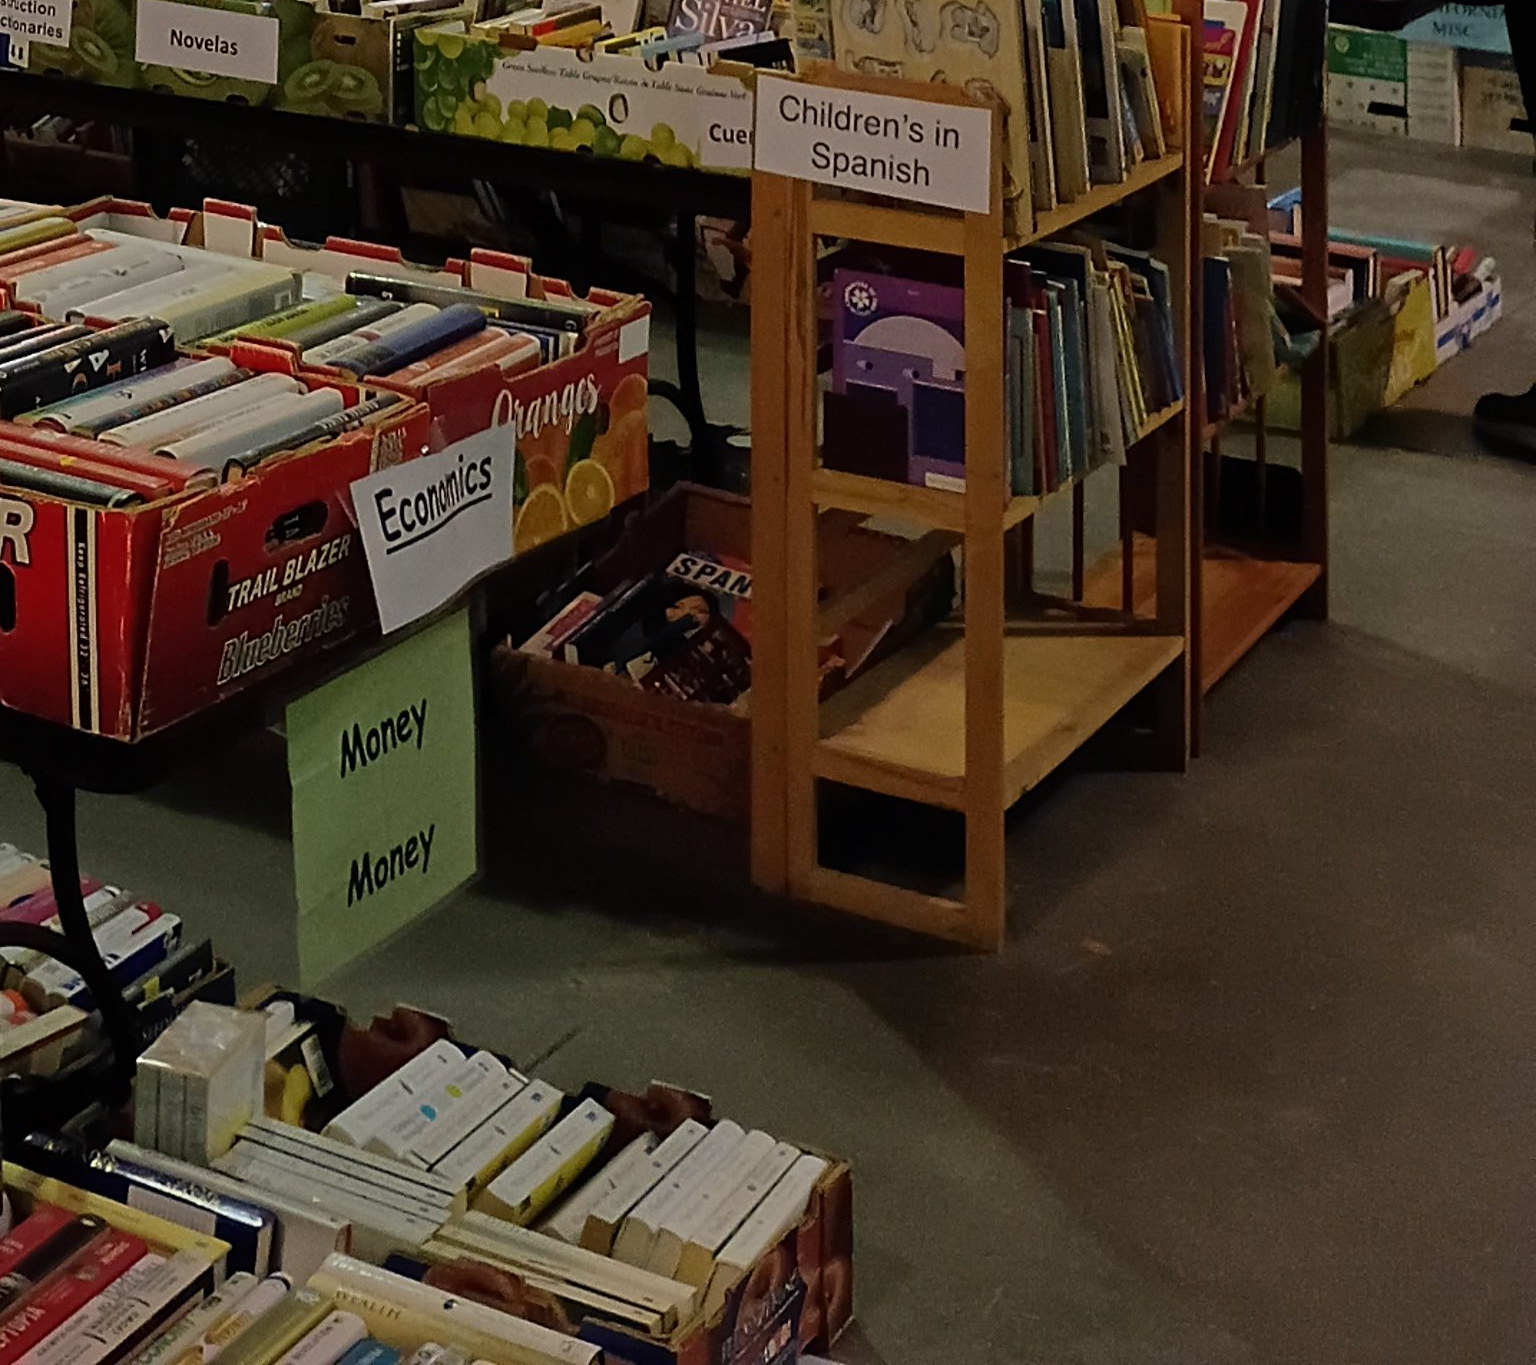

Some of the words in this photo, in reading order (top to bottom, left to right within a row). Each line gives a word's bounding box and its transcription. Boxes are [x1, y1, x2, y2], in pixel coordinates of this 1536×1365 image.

[170, 28, 239, 56] Novelas
[779, 95, 924, 143] Children's
[935, 119, 960, 149] in
[811, 142, 931, 187] Spanish
[374, 454, 491, 544] Economics
[226, 566, 279, 610] TRAIL
[283, 536, 351, 587] BLAZER
[275, 584, 303, 608] BRAND
[217, 593, 352, 684] Blueberries
[340, 698, 427, 779] Money
[347, 823, 436, 907] Money
